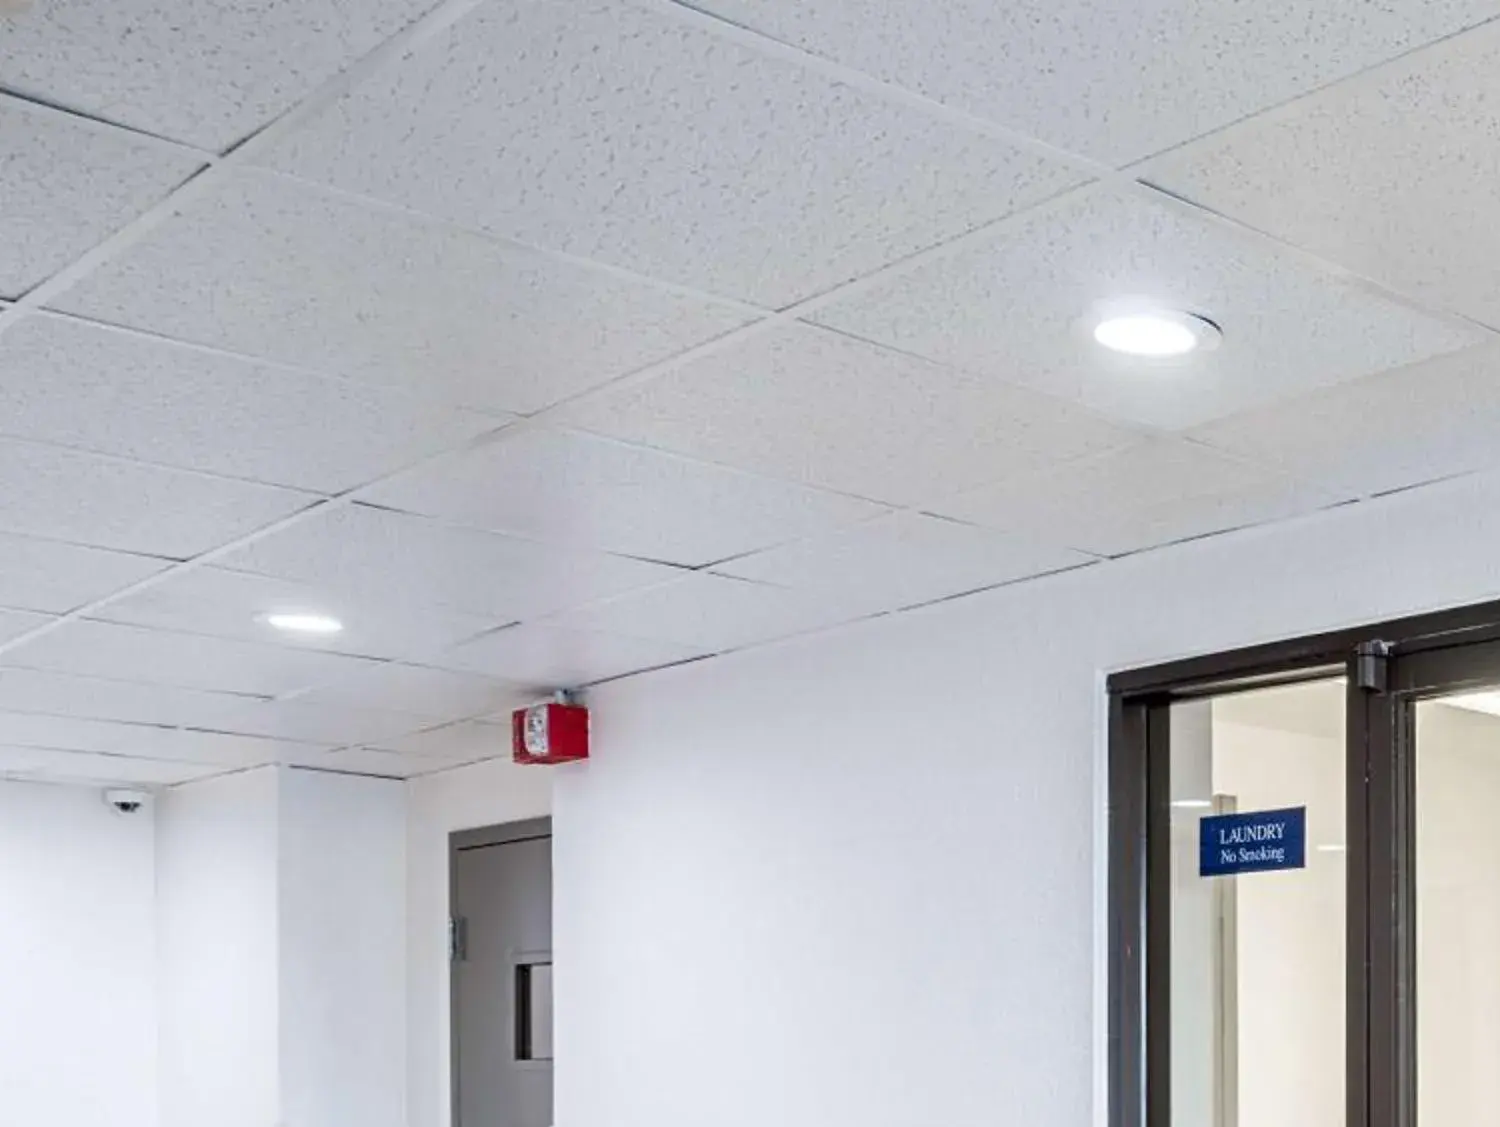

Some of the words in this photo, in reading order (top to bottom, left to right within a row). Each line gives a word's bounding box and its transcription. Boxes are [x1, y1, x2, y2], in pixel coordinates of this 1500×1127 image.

[1219, 822, 1286, 845] LAUNDRY
[1220, 848, 1237, 864] No
[1239, 845, 1285, 863] Smoking
